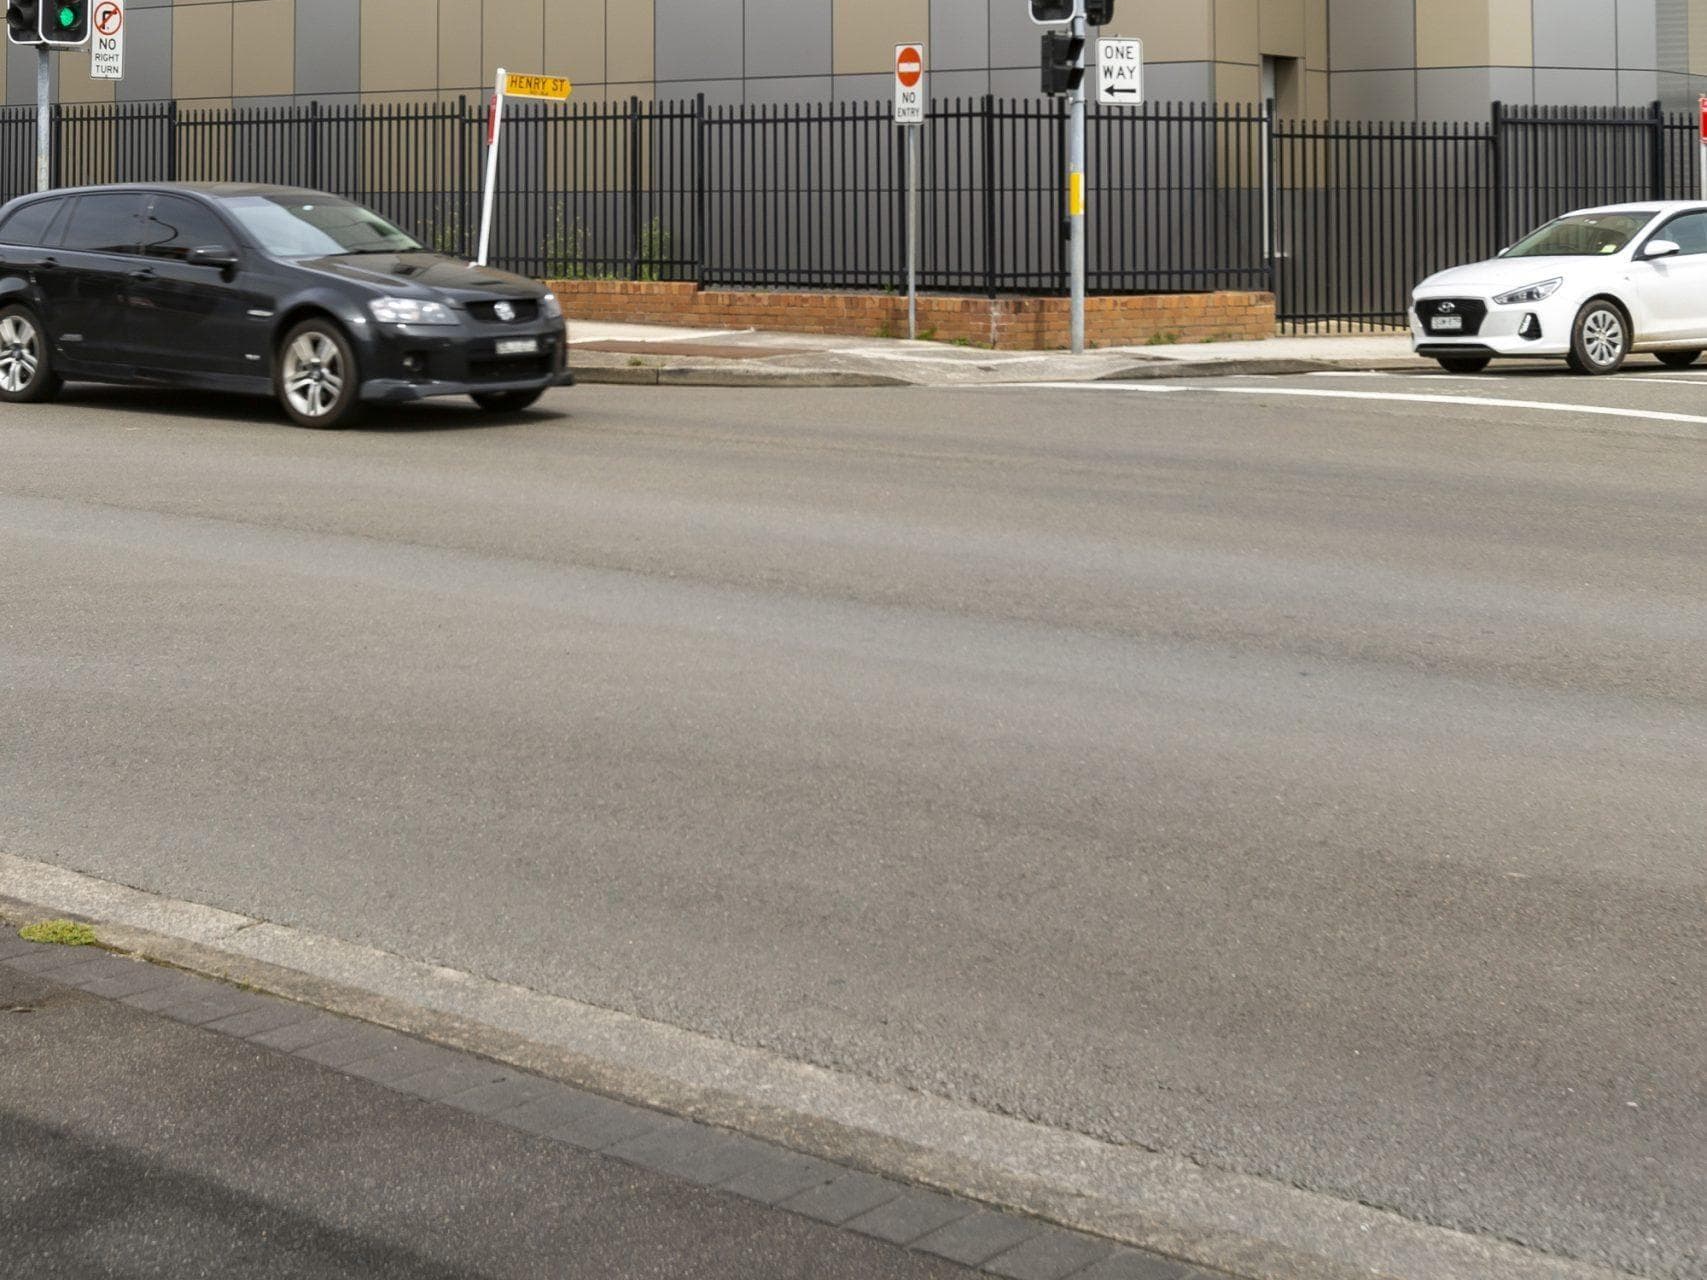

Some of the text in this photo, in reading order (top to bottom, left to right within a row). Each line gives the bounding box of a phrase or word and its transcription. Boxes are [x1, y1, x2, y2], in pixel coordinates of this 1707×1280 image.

[99, 38, 117, 51] NO
[95, 53, 120, 63] RIGHT
[1105, 45, 1134, 60] ONE
[95, 65, 119, 74] TURN
[1103, 65, 1137, 80] WAY
[510, 74, 566, 92] HENRY ST
[902, 91, 916, 104] NO
[897, 107, 920, 118] ENTRY
